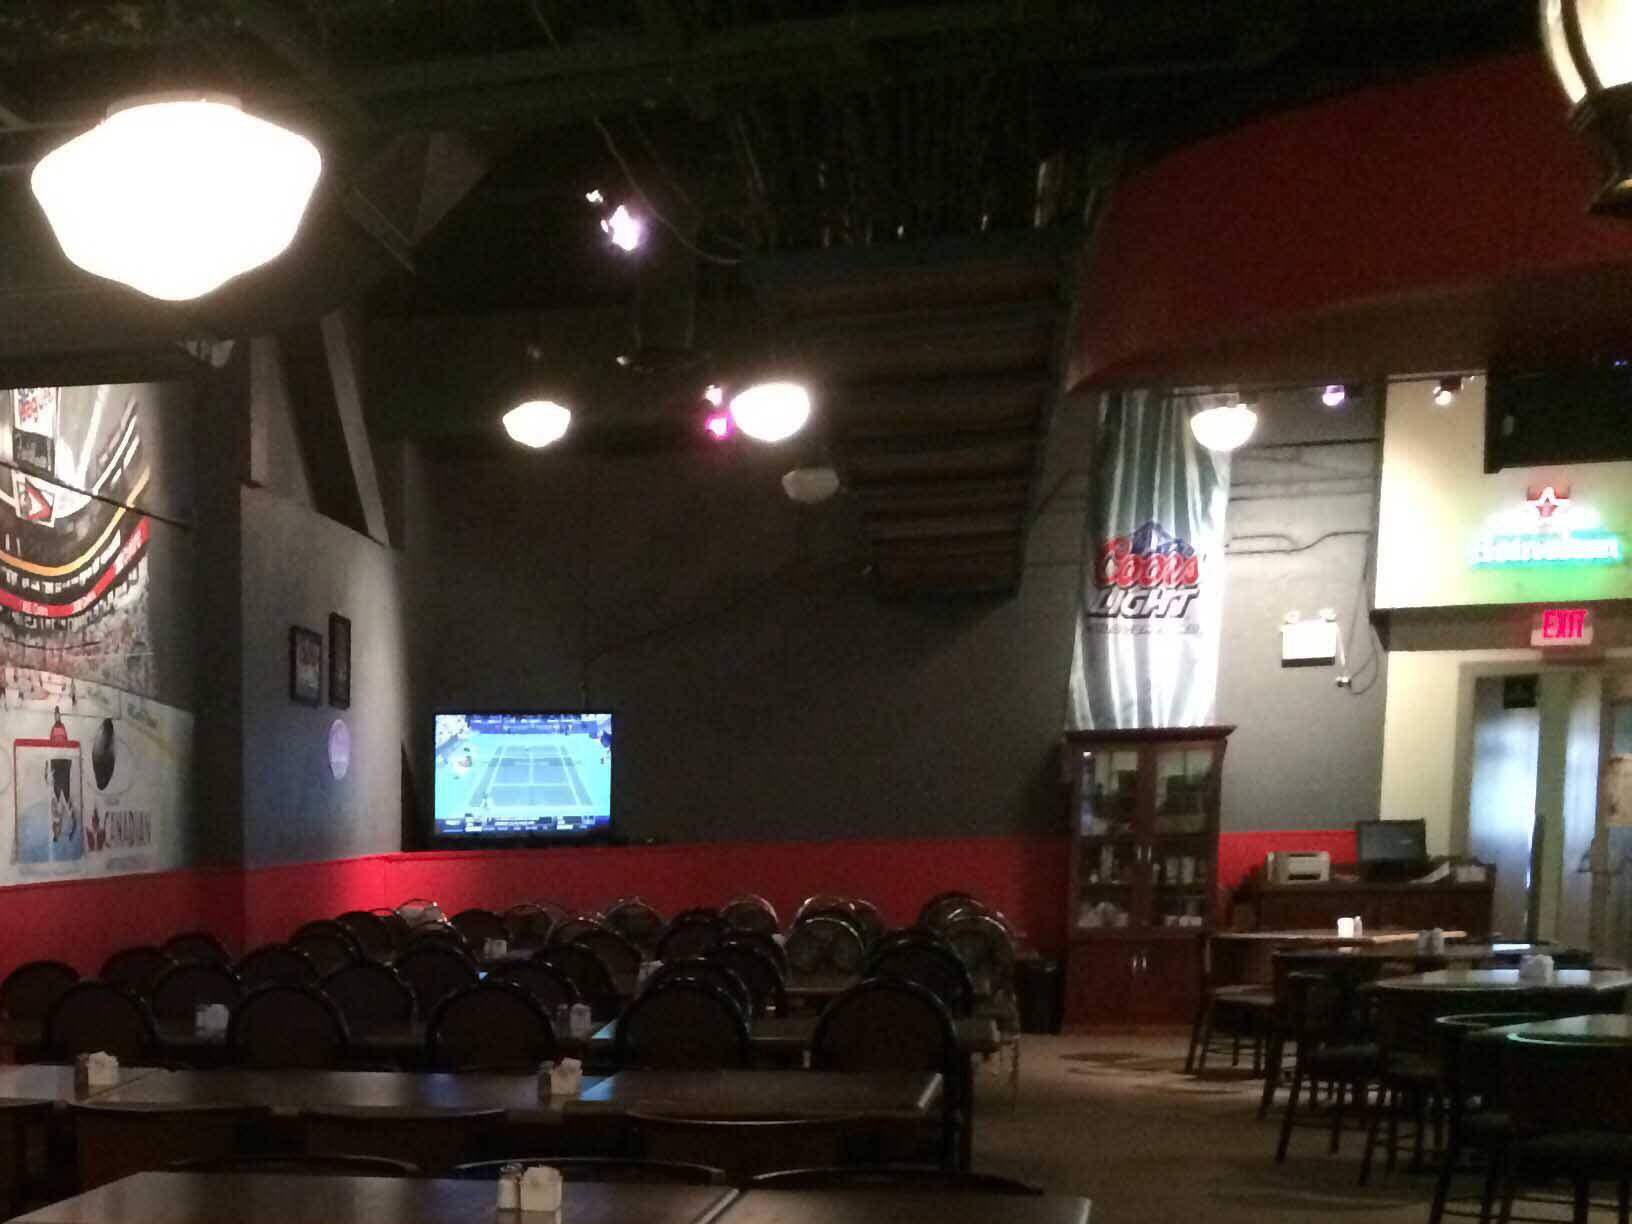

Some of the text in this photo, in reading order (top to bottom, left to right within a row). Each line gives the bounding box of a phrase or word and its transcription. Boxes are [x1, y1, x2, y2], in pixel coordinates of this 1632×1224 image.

[1095, 536, 1199, 588] Coors
[1086, 586, 1200, 619] LIGHT
[1542, 608, 1587, 639] EXIT
